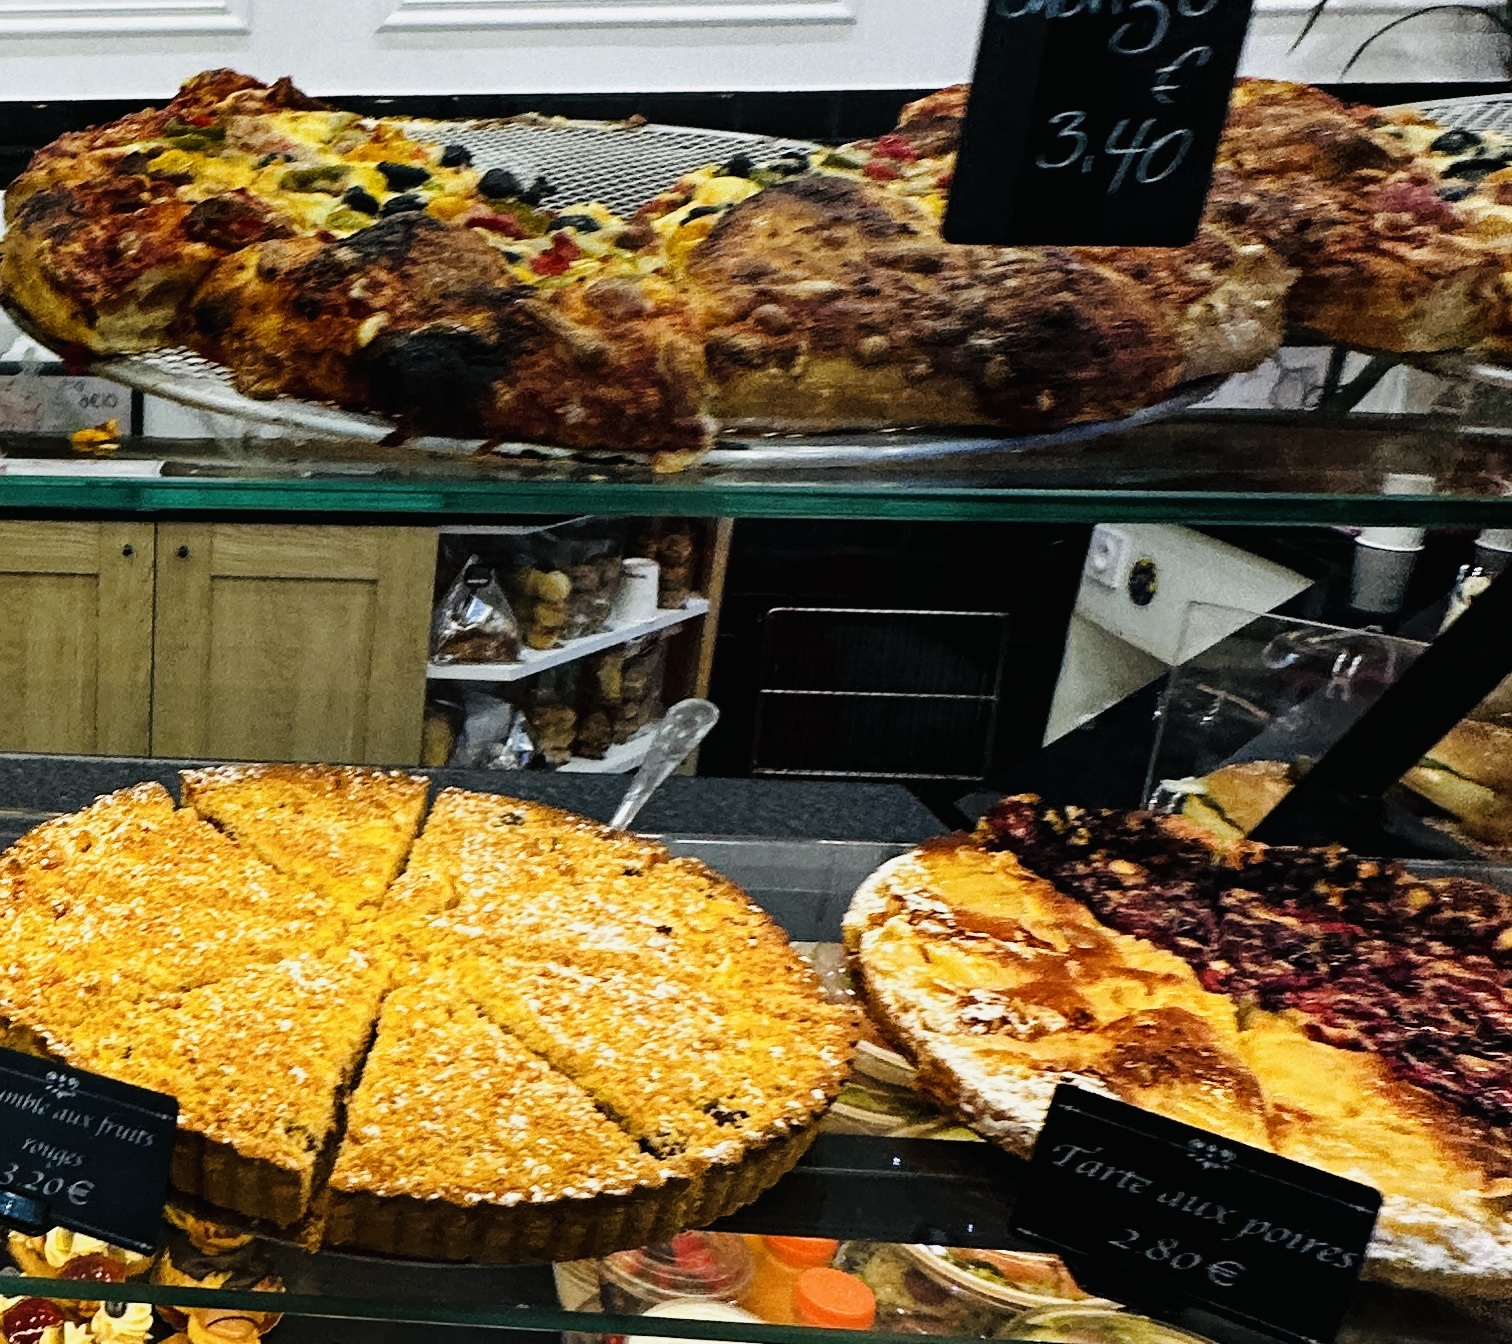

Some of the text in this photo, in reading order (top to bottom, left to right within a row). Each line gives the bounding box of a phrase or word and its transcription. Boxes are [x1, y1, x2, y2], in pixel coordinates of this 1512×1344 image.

[51, 1107, 95, 1129] aux
[1052, 1143, 1360, 1270] Tarte aux poires
